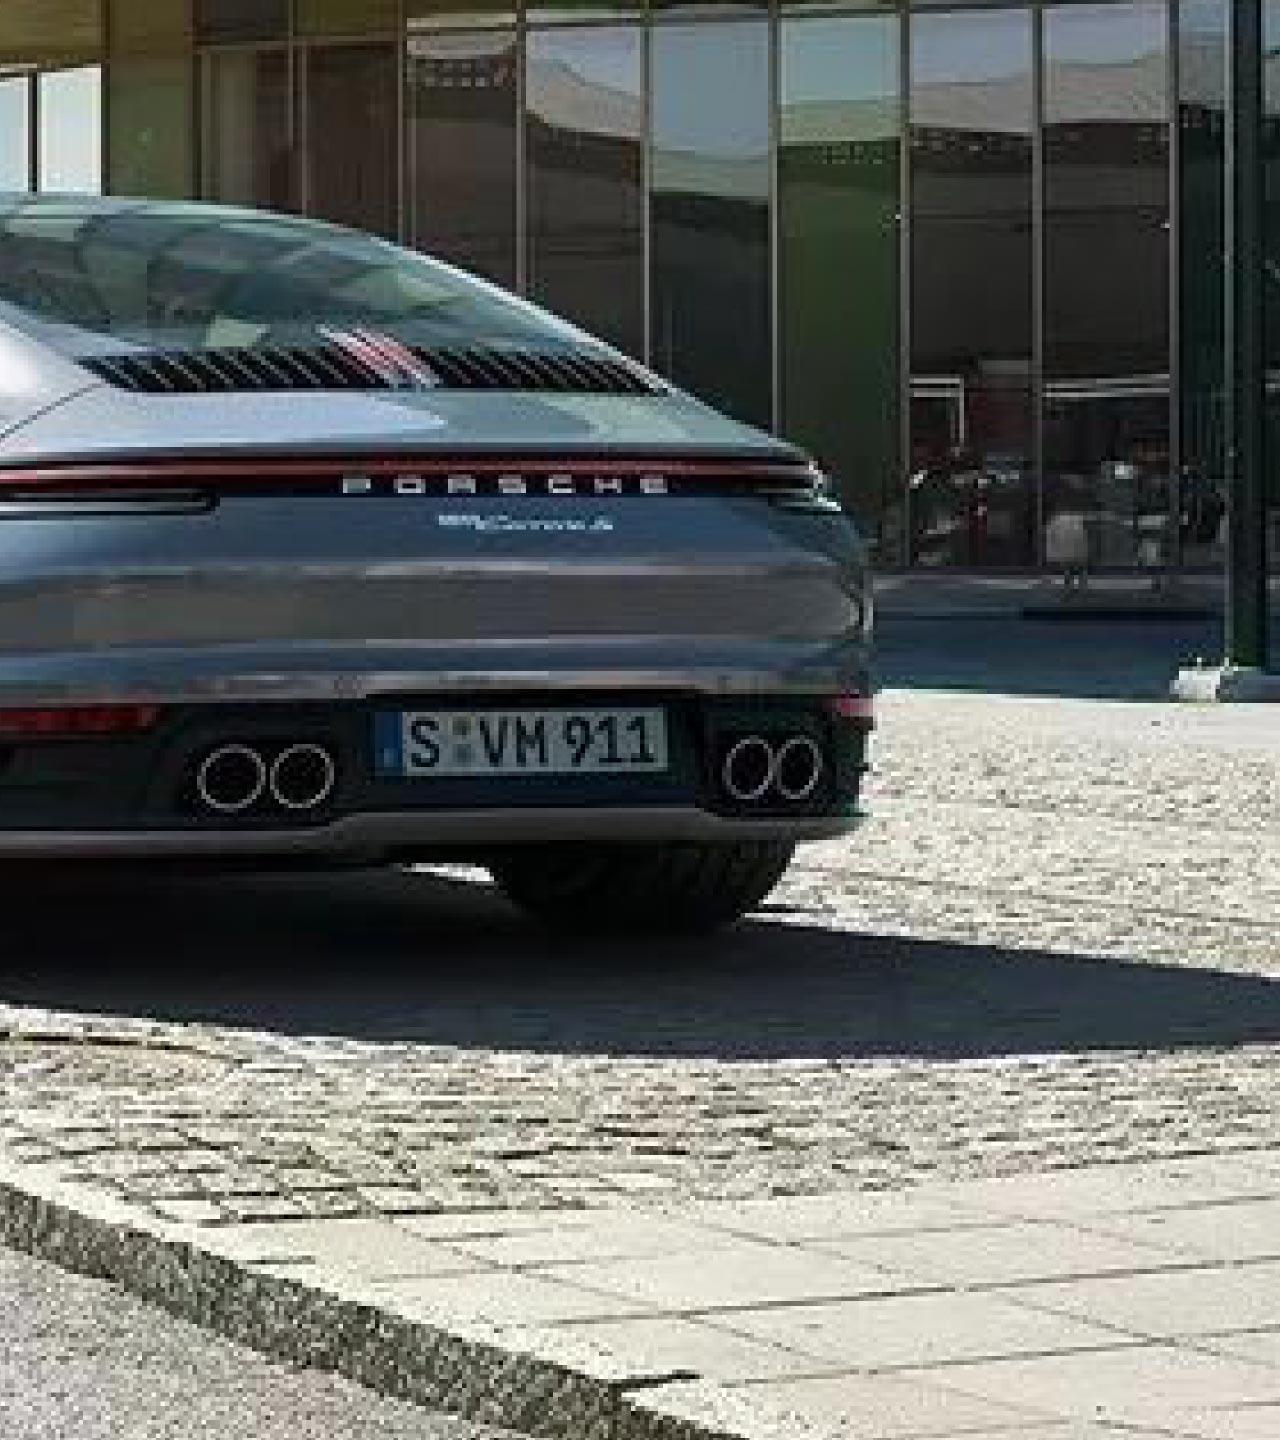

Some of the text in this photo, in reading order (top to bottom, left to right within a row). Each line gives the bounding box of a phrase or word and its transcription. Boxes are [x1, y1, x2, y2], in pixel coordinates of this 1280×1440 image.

[342, 473, 668, 494] PORSCHE
[410, 715, 655, 768] S VM 911
